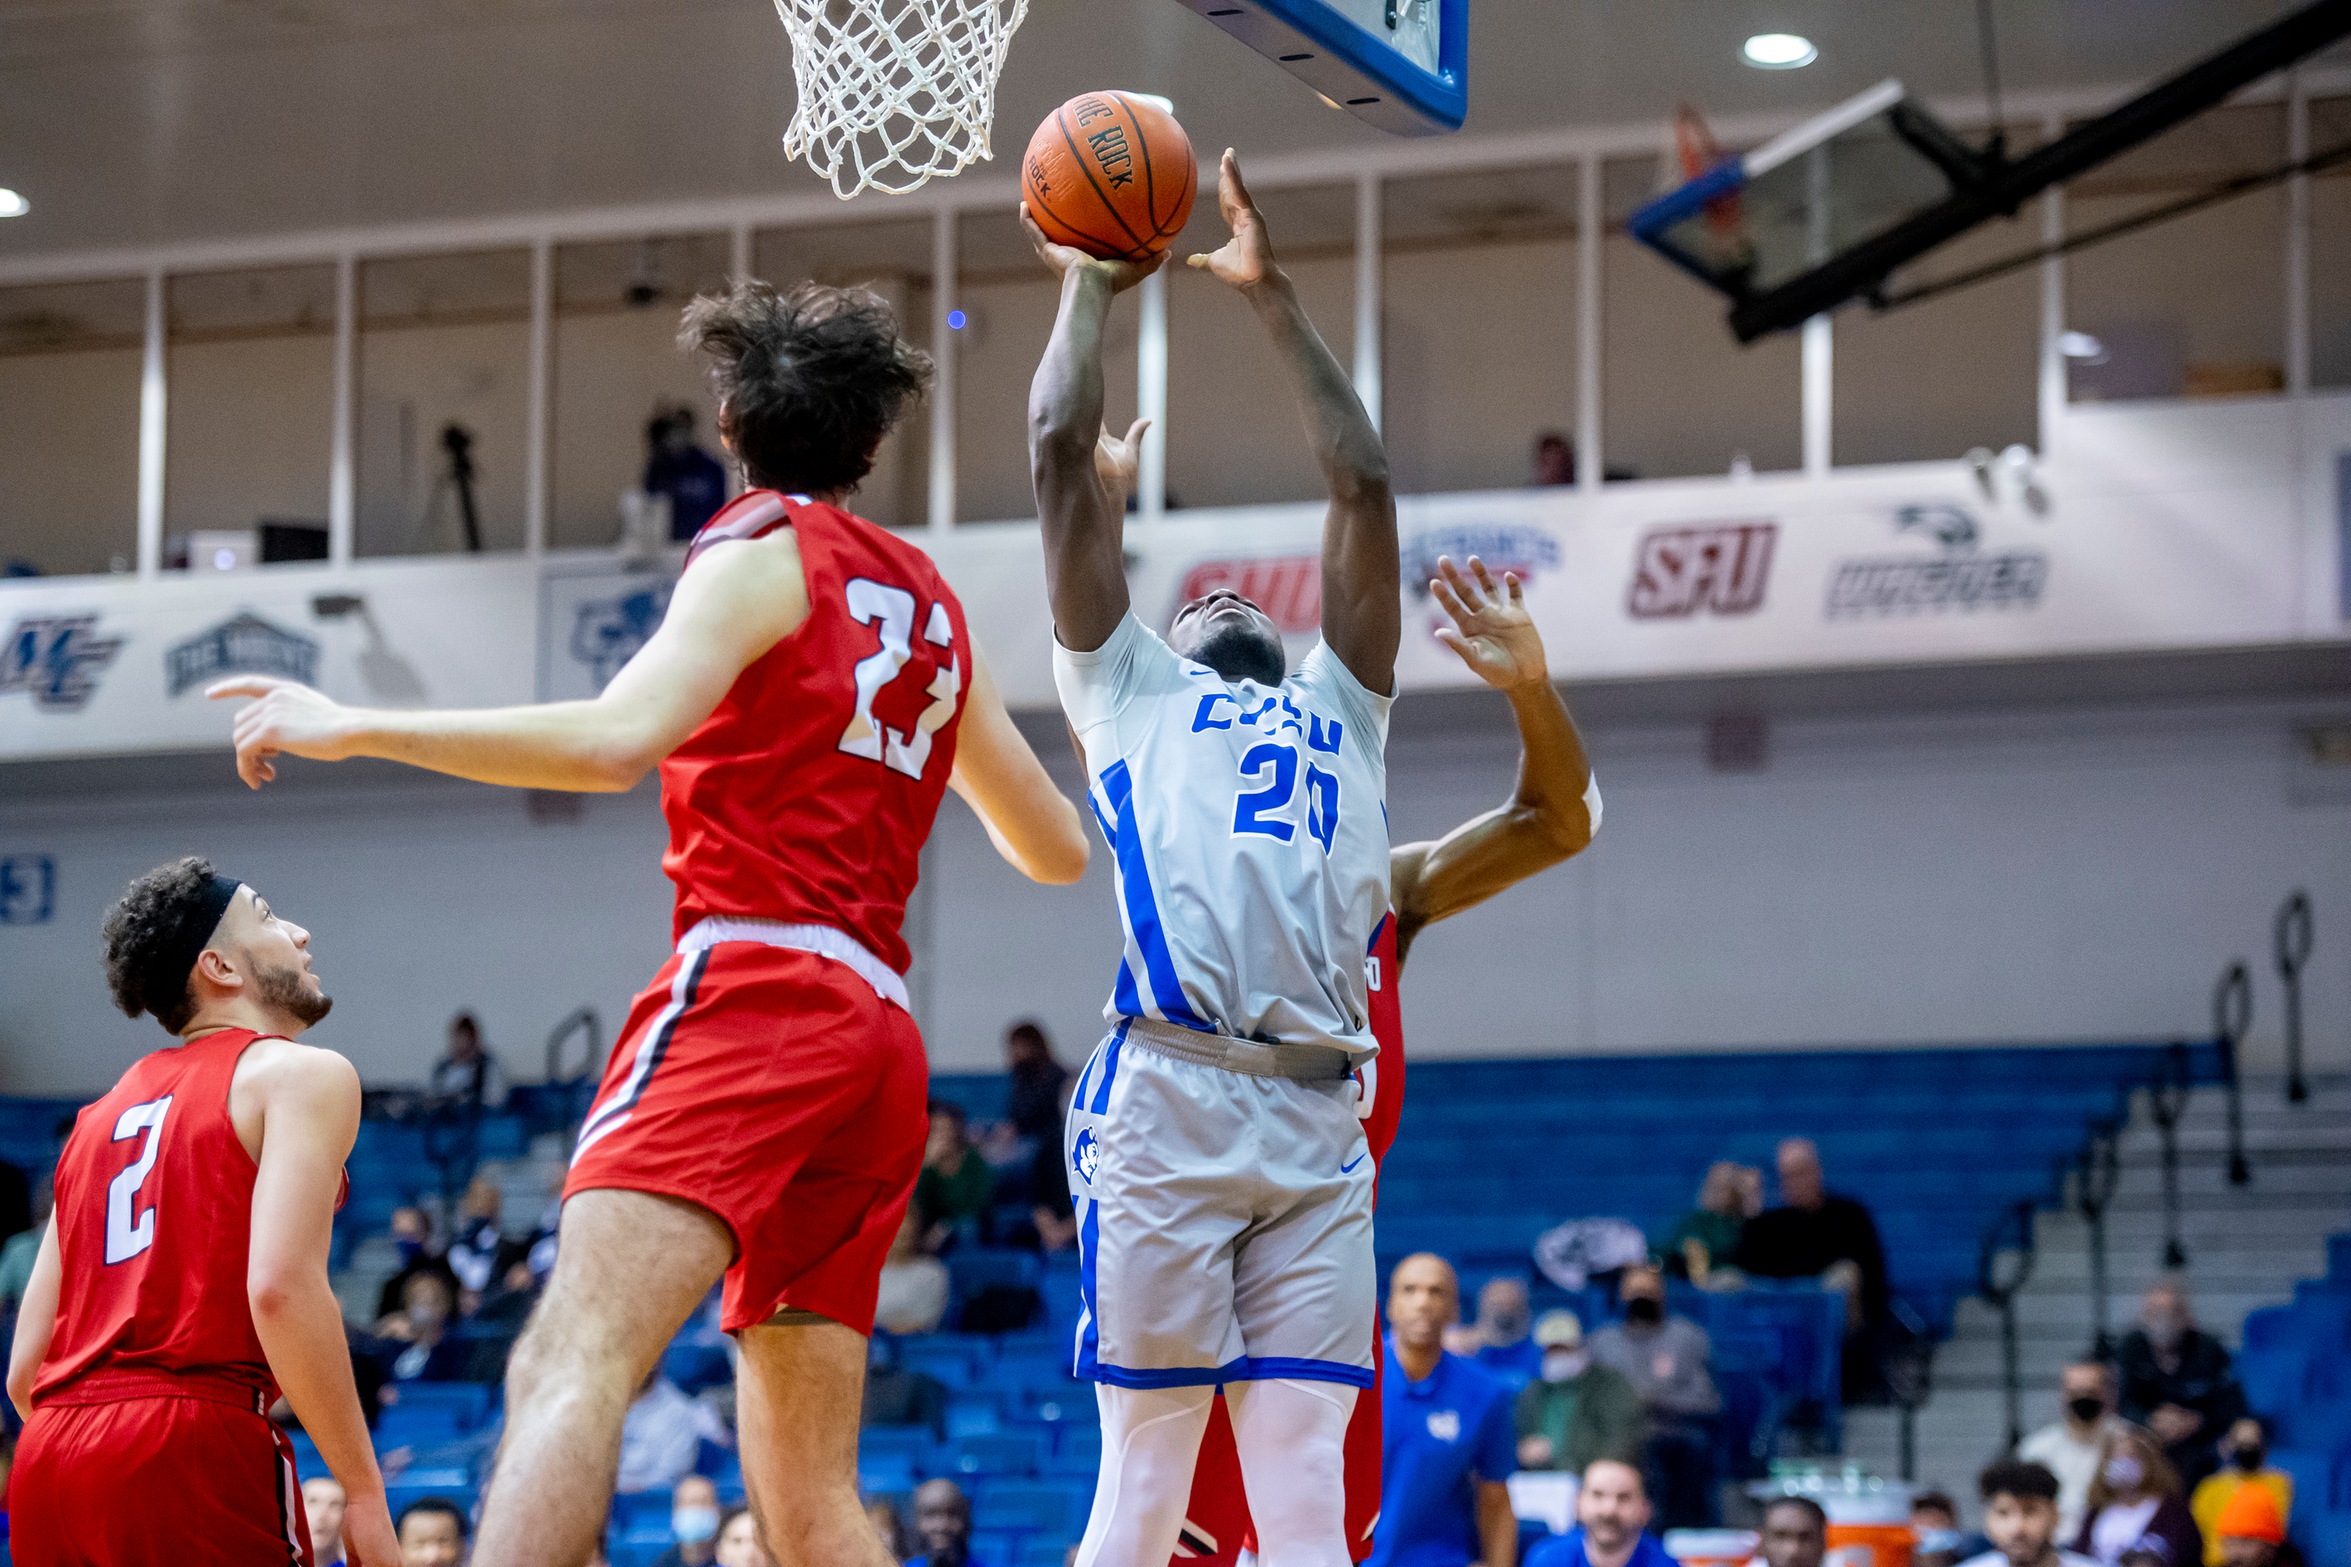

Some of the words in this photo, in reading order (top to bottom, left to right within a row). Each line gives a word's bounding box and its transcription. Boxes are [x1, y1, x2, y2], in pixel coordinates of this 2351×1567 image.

[1073, 96, 1114, 127] THE
[1087, 125, 1133, 190] ROCK
[1028, 154, 1051, 198] ROCK
[1629, 522, 1777, 618] SFU
[837, 577, 963, 782] 23
[1230, 740, 1342, 860] 20
[103, 1094, 174, 1267] 2
